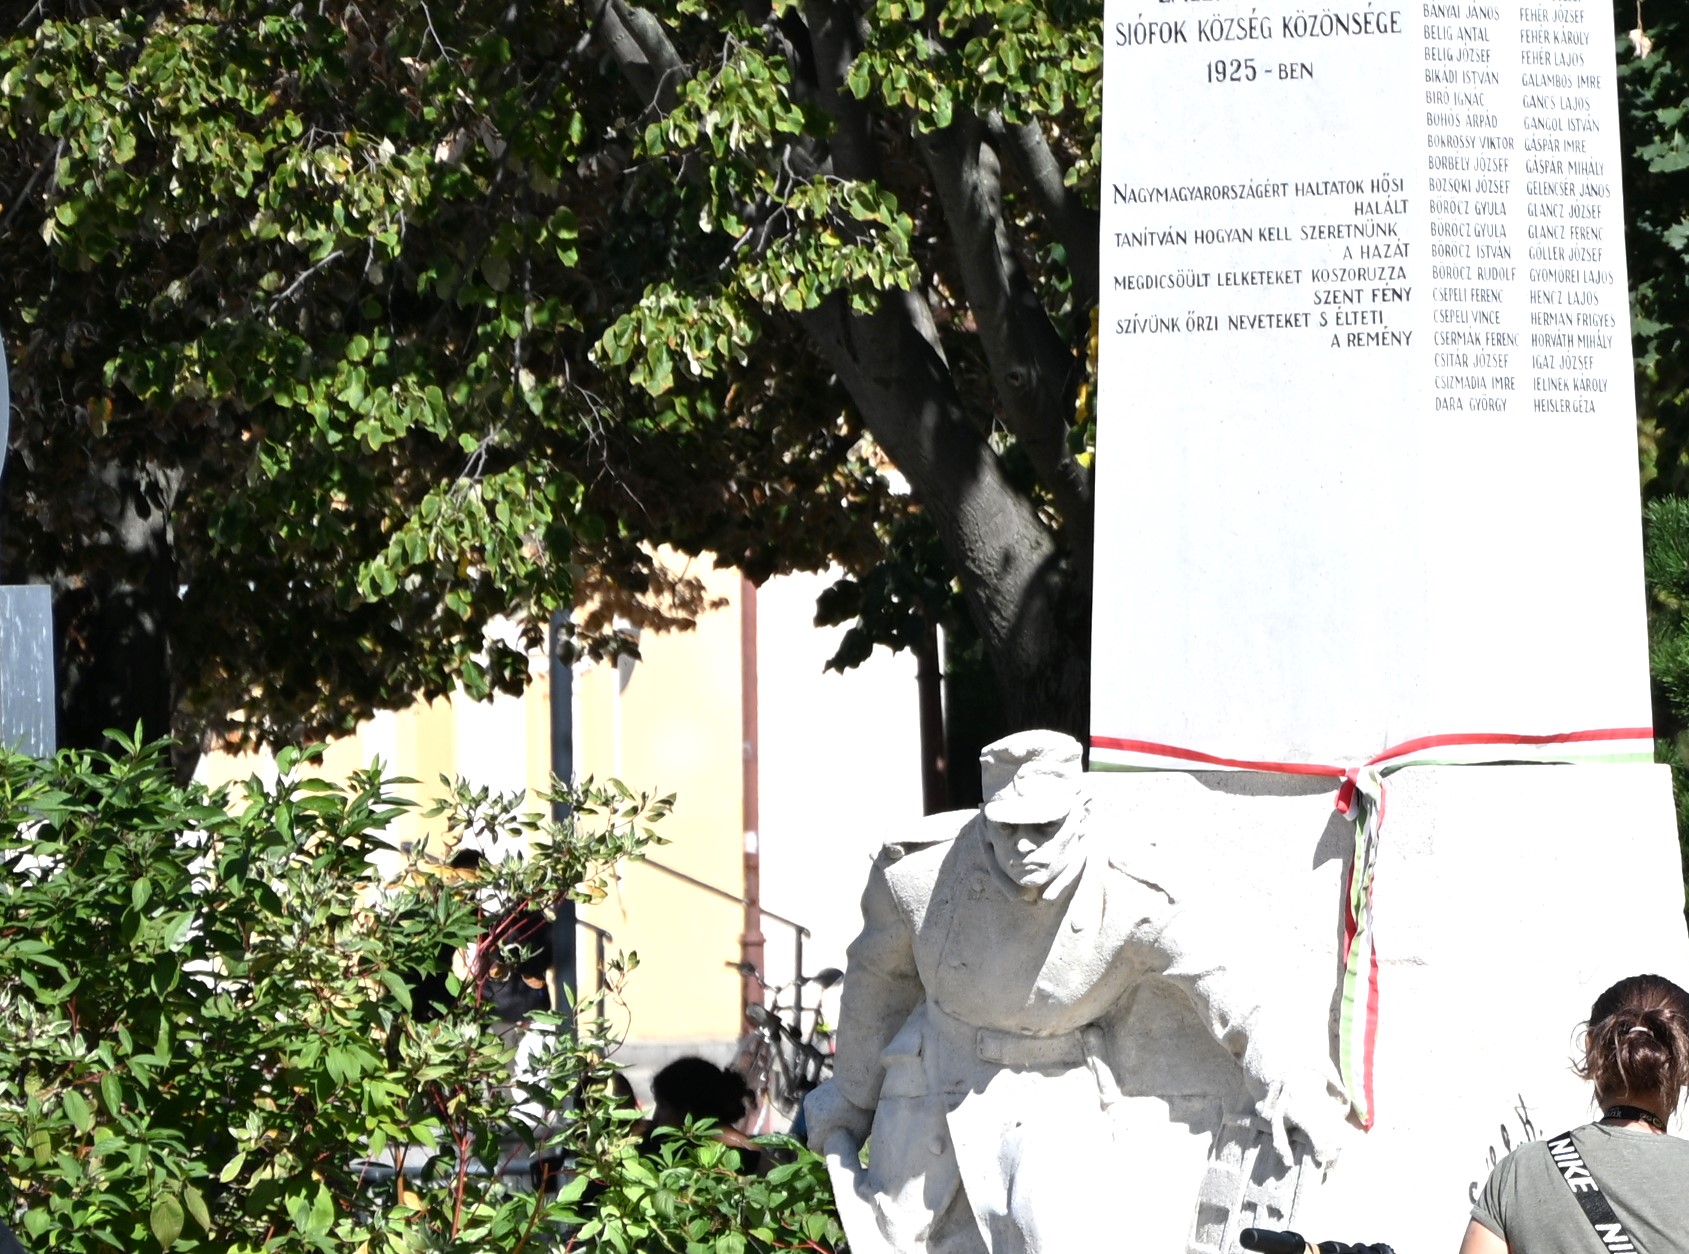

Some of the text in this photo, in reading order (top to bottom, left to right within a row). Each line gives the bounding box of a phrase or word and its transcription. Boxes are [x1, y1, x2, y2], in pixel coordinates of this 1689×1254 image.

[1466, 0, 1500, 21] JÁNOS
[1520, 3, 1585, 23] FEHÉR JÓZSEF
[1116, 2, 1402, 47] SIÓFOK KÖZSÉG KÖZÖNSÉGE
[1424, 25, 1490, 42] BELIG ANTAL
[1520, 24, 1589, 45] FEHÉR KÁROLY
[1425, 43, 1491, 63] BELIG JÓZSEF
[1522, 47, 1585, 67] FEHÉR LAJOS
[1207, 59, 1257, 83] 1925
[1463, 65, 1499, 85] ISTVÁN
[1522, 73, 1601, 89] GALAMBOS IMRE
[1454, 86, 1485, 106] IGNÁC
[1560, 97, 1591, 111] LAJOS
[1466, 108, 1497, 128] ÁRPÁD
[1568, 114, 1600, 132] ISTVÁN
[1479, 136, 1514, 150] VIKTOR
[1525, 134, 1586, 153] GÁSPÁR IMRE
[1474, 152, 1509, 172] JÓZSEF
[1526, 155, 1604, 176] GÁSPÁR MIHÁLY
[1295, 179, 1364, 196] HALTATOK
[1371, 173, 1403, 193] HŐSI
[1475, 175, 1510, 194] JÓZSEF
[1579, 178, 1611, 198] JÁNOS
[1354, 194, 1408, 216] HALÁLT
[1475, 201, 1506, 216] GYULA
[1528, 199, 1602, 219] GLANCZ JÓZSEF
[1114, 219, 1398, 247] TANÍTVÁN HOGYAN KELL SZERETNÜNK
[1474, 223, 1506, 238] GYULA
[1528, 225, 1603, 241] GLANCZ FERENC
[1343, 238, 1410, 260] A HAZÁT
[1477, 240, 1511, 259] ISTVÁN
[1569, 243, 1603, 262] JÓZSEF
[1217, 269, 1302, 286] LELKETEKET
[1311, 266, 1406, 283] KOSZORUZZA
[1478, 267, 1517, 281] RUDOLF
[1584, 270, 1614, 284] LAJOS
[1313, 282, 1412, 305] SZENT FÉNY
[1433, 287, 1503, 303] CSEPELI FERENC
[1530, 290, 1599, 305] HENCZ LAJOS
[1115, 305, 1384, 335] SZÍVÜNK ŐRZI NEVETEKET S ÉLTETI
[1434, 309, 1500, 324] CSEPELI VINCE
[1531, 312, 1616, 327] HERMAN FRIGYES
[1330, 326, 1413, 348] A REMÉNY
[1434, 326, 1519, 346] CSERMÁK FERENC
[1532, 329, 1613, 349] HORVÁTH MIHÁLY
[1473, 348, 1509, 368] JÓZSEF
[1532, 350, 1594, 370] IGAZ JÓZSEF
[1435, 375, 1515, 390] CSIZMADIA IMRE
[1574, 372, 1608, 392] KÁROLY
[1436, 394, 1507, 412] DARA GYÖRGY
[1573, 395, 1595, 413] GÉZA
[1548, 1139, 1598, 1194] NIKE
